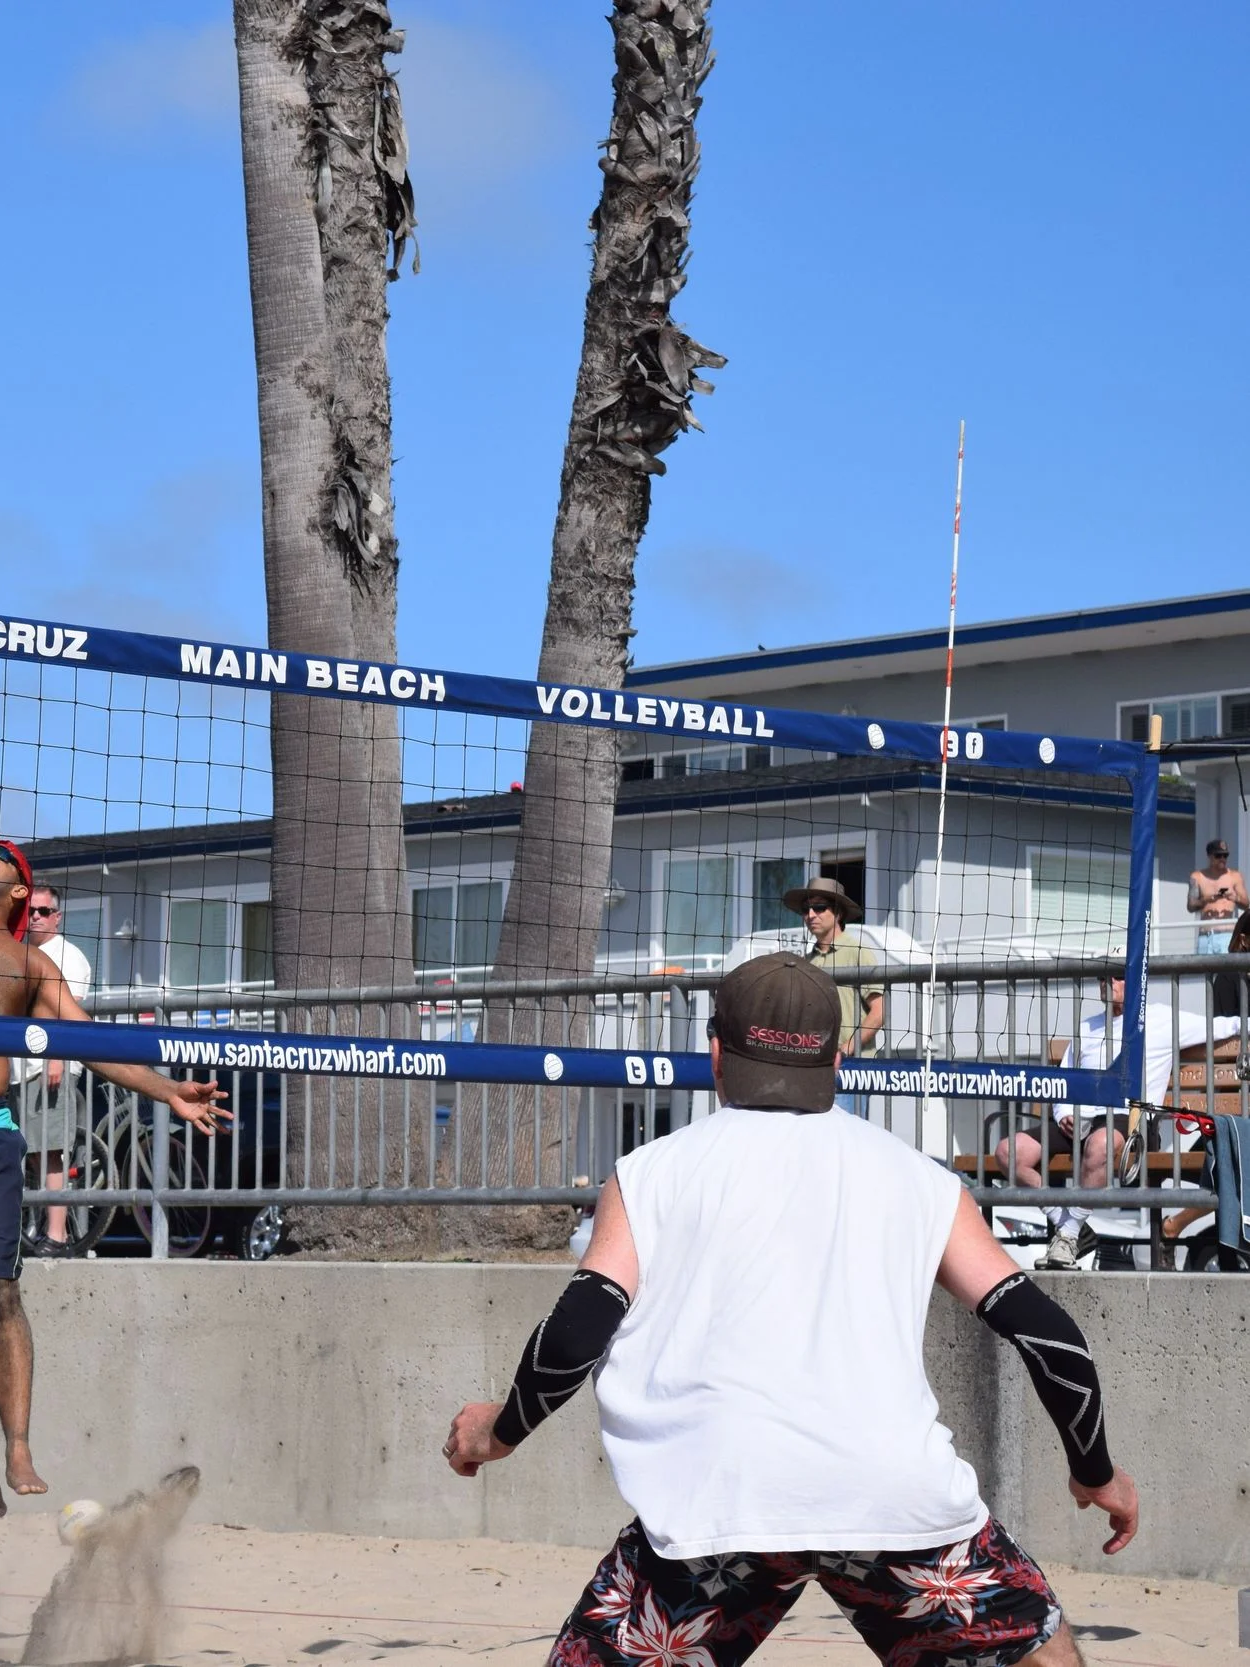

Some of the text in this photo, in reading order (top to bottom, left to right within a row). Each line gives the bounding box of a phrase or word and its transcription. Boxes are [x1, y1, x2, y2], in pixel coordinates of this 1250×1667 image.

[180, 643, 775, 739] MAIN BEACH VOLLEYBALL
[745, 1039, 821, 1055] SKATEBOARDING
[746, 1025, 822, 1047] SESSIONS
[158, 1037, 447, 1077] www.santacruzwharf.com
[838, 1065, 1068, 1099] www.santacruzwharf.com
